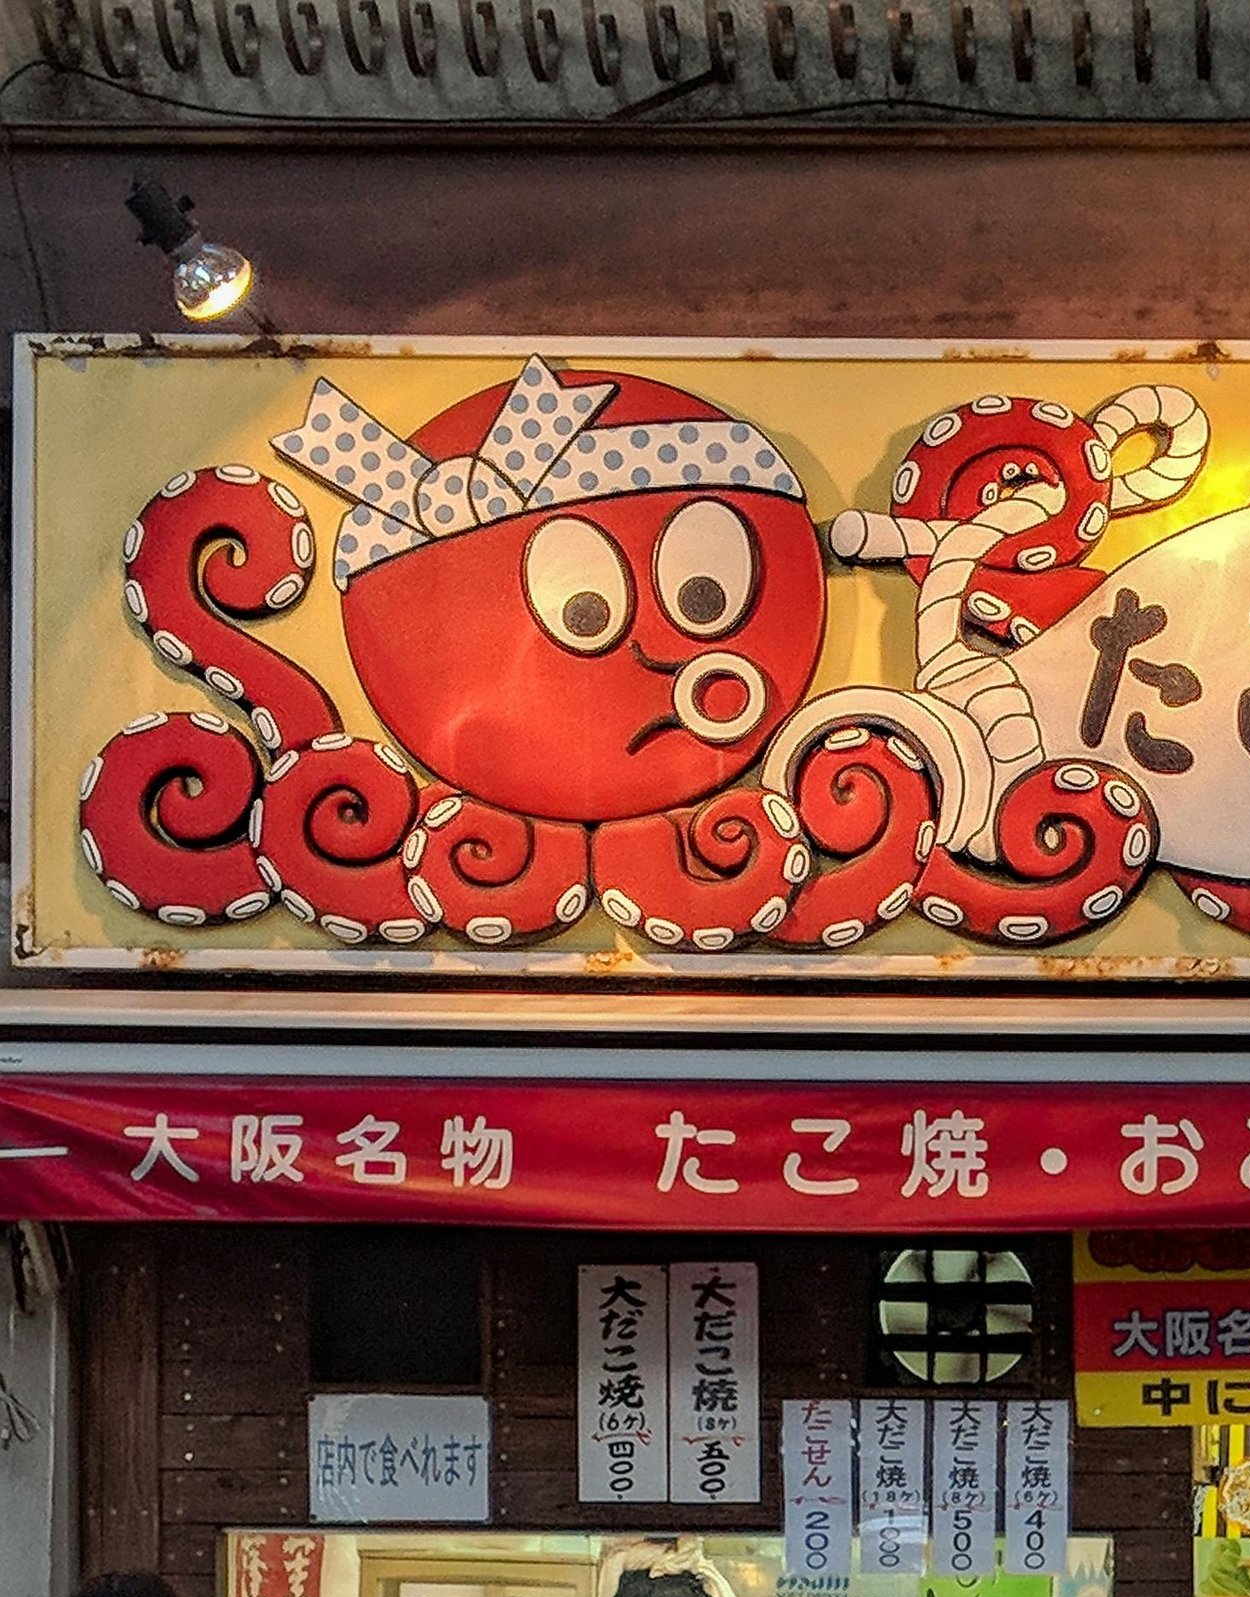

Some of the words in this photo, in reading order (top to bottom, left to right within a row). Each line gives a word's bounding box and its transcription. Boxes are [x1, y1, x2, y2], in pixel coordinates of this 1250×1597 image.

[123, 1111, 516, 1191] 大阪名物
[598, 1275, 647, 1410] 大だこ焼
[691, 1276, 738, 1413] 大だこ焼
[317, 1433, 482, 1487] 店内で食べれます
[801, 1400, 832, 1489] たこせん
[876, 1400, 908, 1488] 大だこ焼
[949, 1400, 981, 1489] 大だこ焼
[1021, 1400, 1052, 1489] 大だこ焼
[805, 1511, 830, 1570] 200
[951, 1510, 972, 1571] 500
[1024, 1510, 1046, 1569] 400
